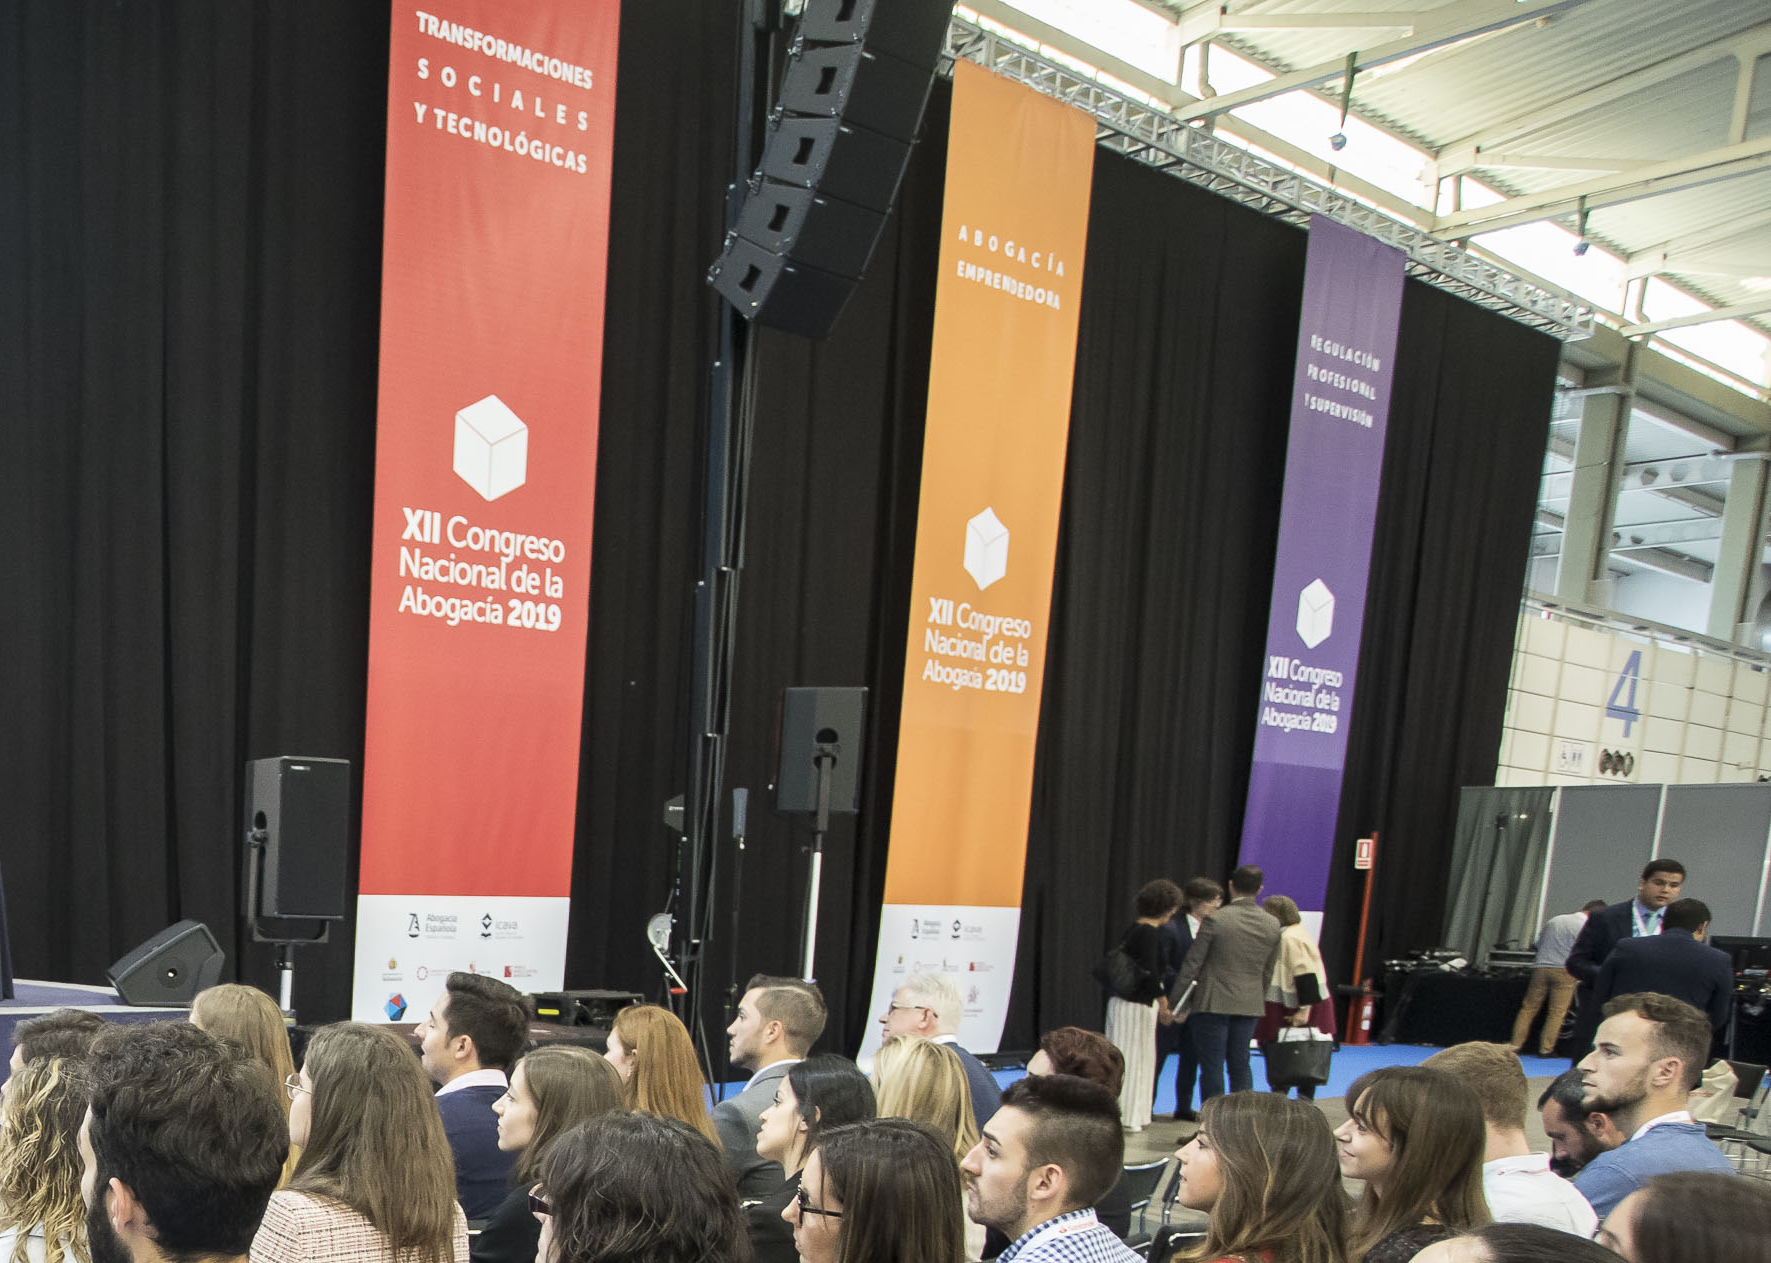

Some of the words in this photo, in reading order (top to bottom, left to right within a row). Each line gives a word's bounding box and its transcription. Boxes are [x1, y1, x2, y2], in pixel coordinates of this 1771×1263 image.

[416, 10, 593, 90] TRANSFORMACIONES
[417, 58, 588, 131] SOCIALES
[414, 102, 427, 123] Y
[433, 108, 587, 174] TECNOLÓGICAS
[958, 225, 1064, 277] ABOGACÍA
[956, 260, 1061, 310] EMPRENDEDORA
[1310, 334, 1381, 372] REGULACIÓN
[1307, 363, 1377, 400] PROFESIONAL
[1310, 396, 1374, 429] SUPERVISIÓN
[401, 507, 441, 545] XII
[446, 515, 566, 564] Congreso
[399, 546, 507, 592] Nacional
[510, 564, 541, 596] de
[544, 568, 564, 599] la
[398, 585, 504, 627] Abogacía
[507, 599, 562, 632] 2019
[927, 597, 954, 626] XII
[956, 602, 1032, 640] Congreso
[924, 628, 988, 662] Nacional
[989, 641, 1014, 665] de
[1016, 643, 1029, 668] la
[922, 659, 983, 692] Abogacía
[985, 668, 1027, 694] 2019
[1268, 655, 1289, 679] XII
[1289, 658, 1343, 689] Congreso
[1605, 650, 1642, 738] 4
[1264, 681, 1316, 708] Nacional
[1316, 689, 1330, 710] de
[1330, 691, 1340, 712] la
[1261, 707, 1312, 733] Abogacía
